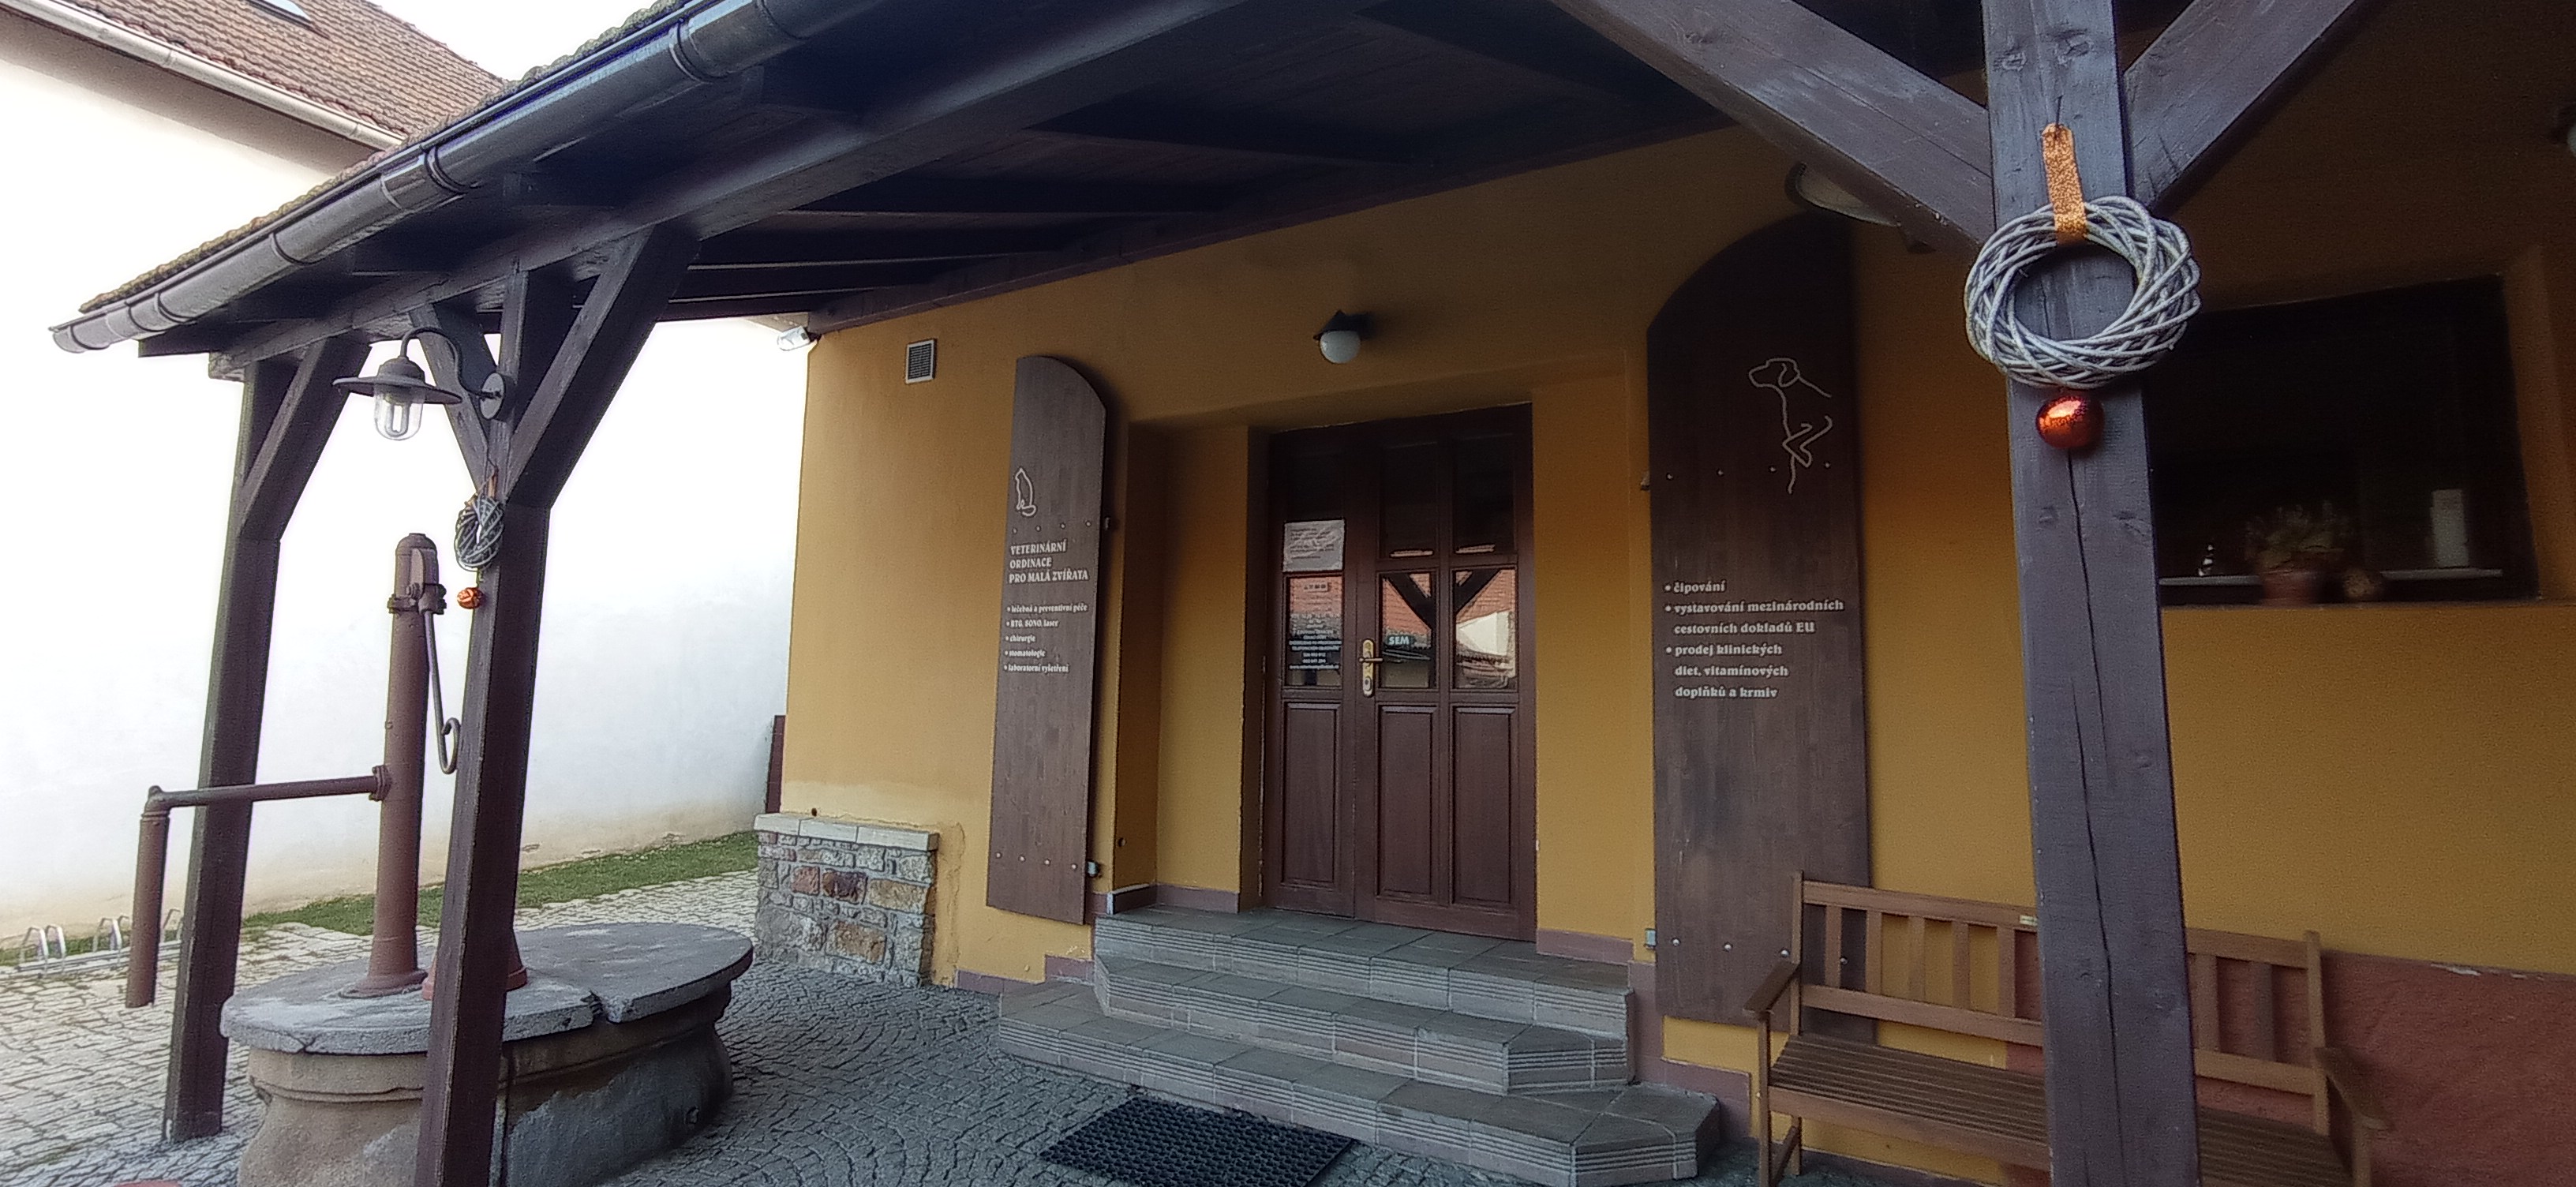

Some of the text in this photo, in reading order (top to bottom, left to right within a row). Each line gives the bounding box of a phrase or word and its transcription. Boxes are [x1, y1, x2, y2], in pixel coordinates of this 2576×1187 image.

[1010, 538, 1067, 556] VETERINÁRNÍ
[1010, 556, 1052, 569] ORDINACE
[1009, 567, 1088, 584] PRO MALÁ ZVÍŘATA
[1674, 580, 1725, 594] čipování
[1039, 603, 1073, 613] preventivní
[1073, 602, 1088, 612] péče
[1674, 599, 1844, 615] vystavování mezinárodních
[1674, 621, 1815, 634] cestovních dokladů EU
[1010, 635, 1036, 643] chirurgie
[1389, 636, 1410, 645] SEM
[1009, 650, 1046, 658] stomatologie
[1675, 644, 1782, 657] prodej klinických
[1042, 664, 1069, 674] vyšetření
[1704, 665, 1789, 679] vitamínových
[1675, 686, 1726, 699] doplňků
[1739, 686, 1778, 698] krmiv
